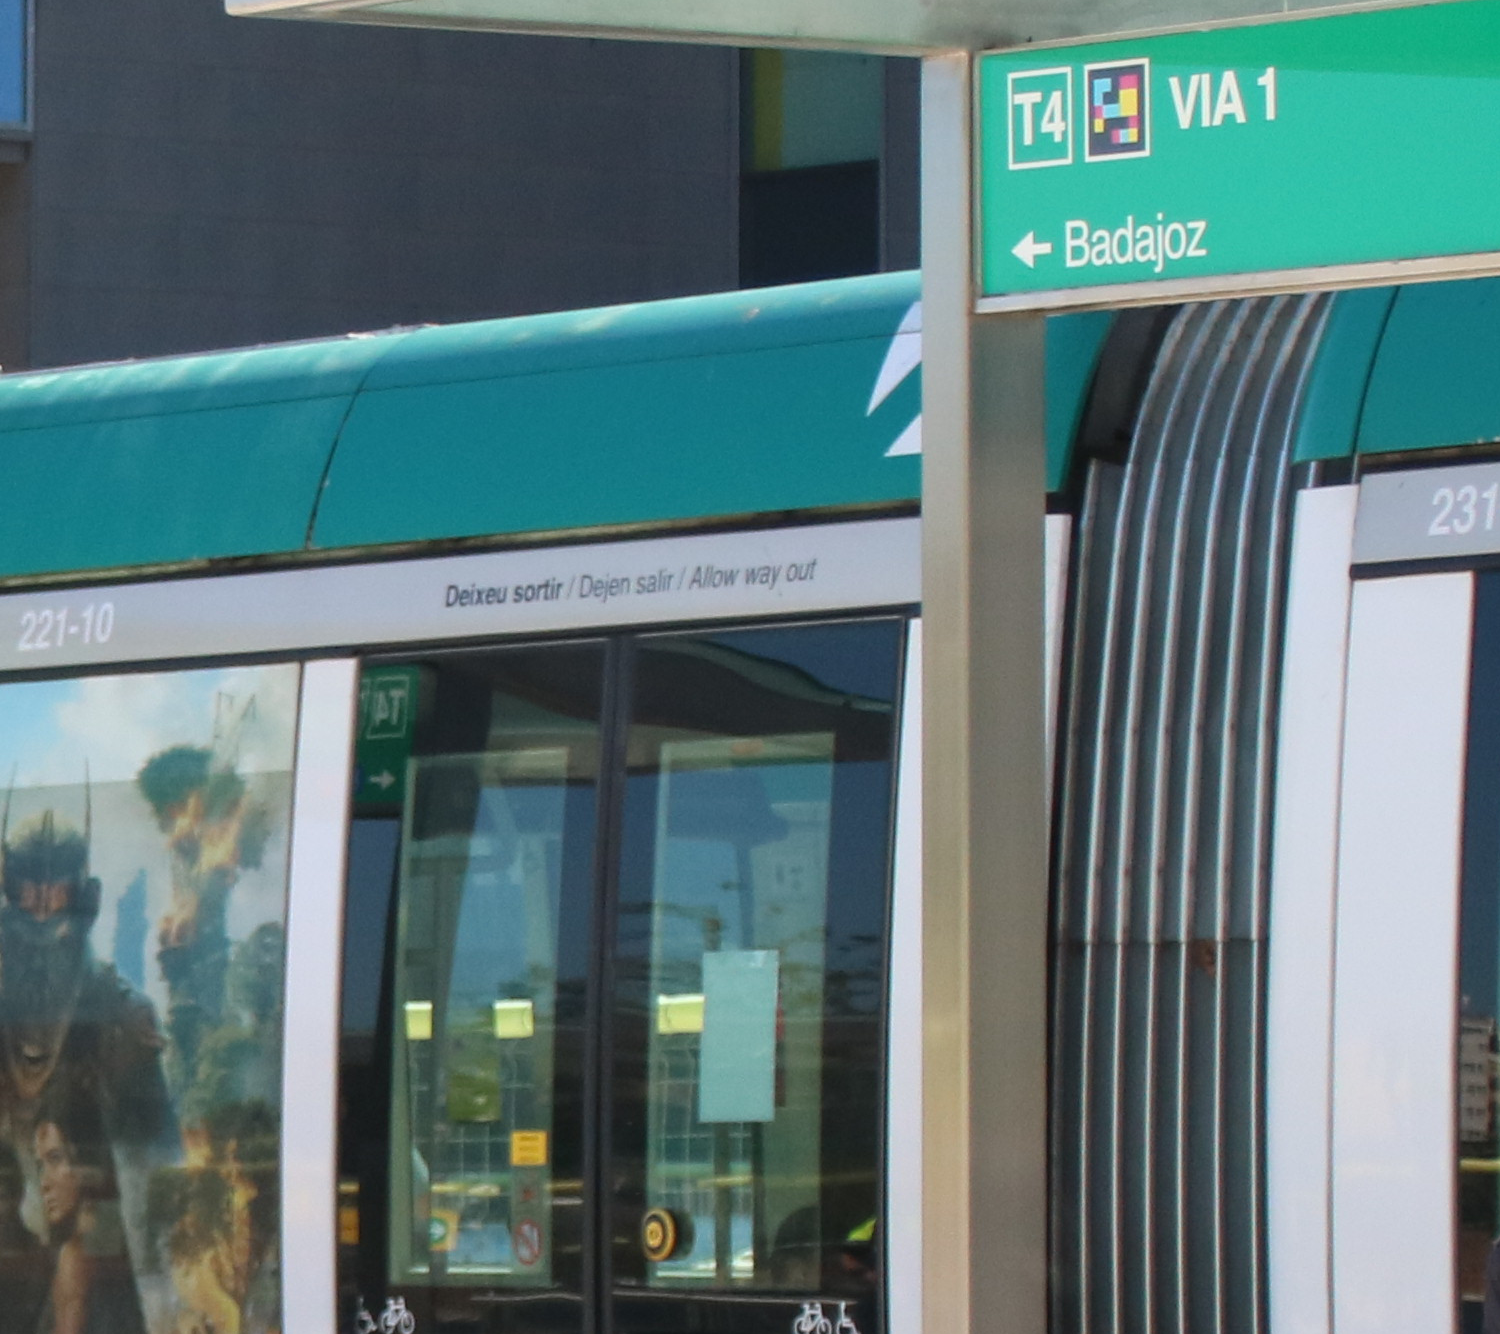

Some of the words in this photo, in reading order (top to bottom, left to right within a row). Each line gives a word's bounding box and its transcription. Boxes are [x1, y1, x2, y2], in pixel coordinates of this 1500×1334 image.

[1013, 90, 1067, 146] T4
[1169, 70, 1247, 130] VIA
[1257, 67, 1276, 121] 1
[1065, 212, 1208, 273] Badajoz
[445, 583, 507, 608] Deixeu
[512, 576, 564, 604] sortir
[578, 573, 630, 605] Dejen
[636, 570, 674, 596] salir
[688, 565, 739, 590] Allow
[745, 565, 780, 590] way
[786, 558, 818, 583] out
[17, 602, 115, 651] 221-10
